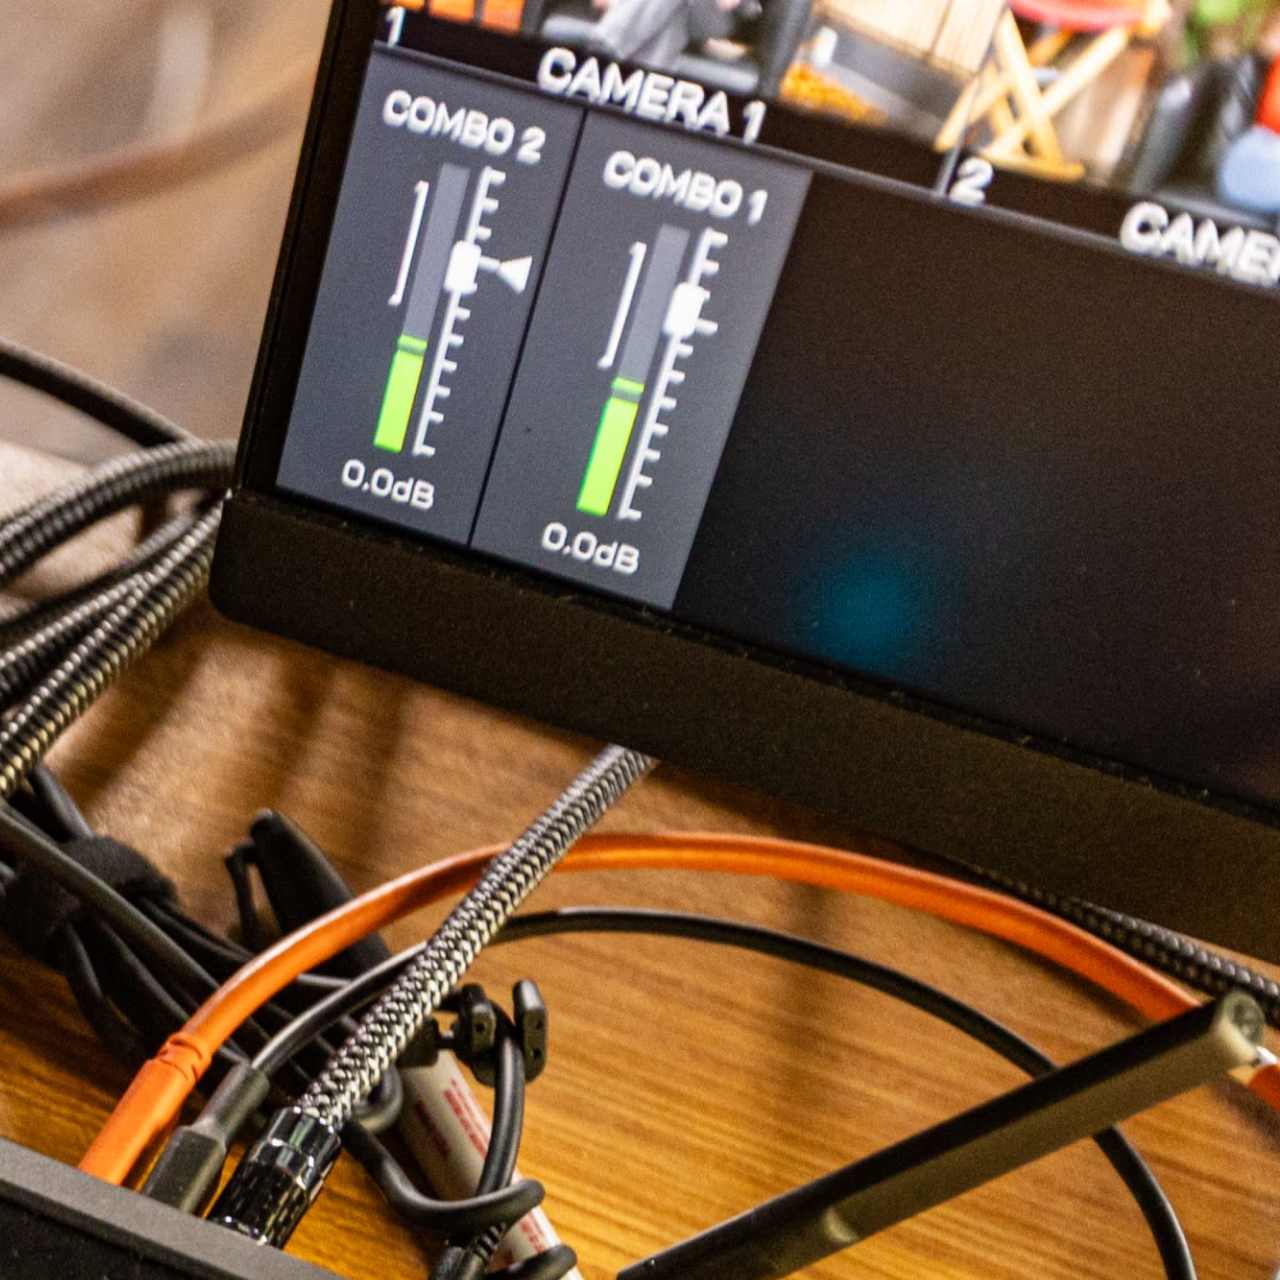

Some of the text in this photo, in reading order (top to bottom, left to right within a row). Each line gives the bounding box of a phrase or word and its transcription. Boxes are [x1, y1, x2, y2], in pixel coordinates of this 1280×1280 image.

[385, 6, 406, 48] 1
[537, 46, 766, 145] CAMERA 1
[383, 89, 546, 164] COMBO 2
[603, 150, 768, 226] COMBO 1
[949, 157, 993, 206] 2
[341, 458, 436, 510] 0.0dB
[541, 522, 640, 574] 0.0dB
